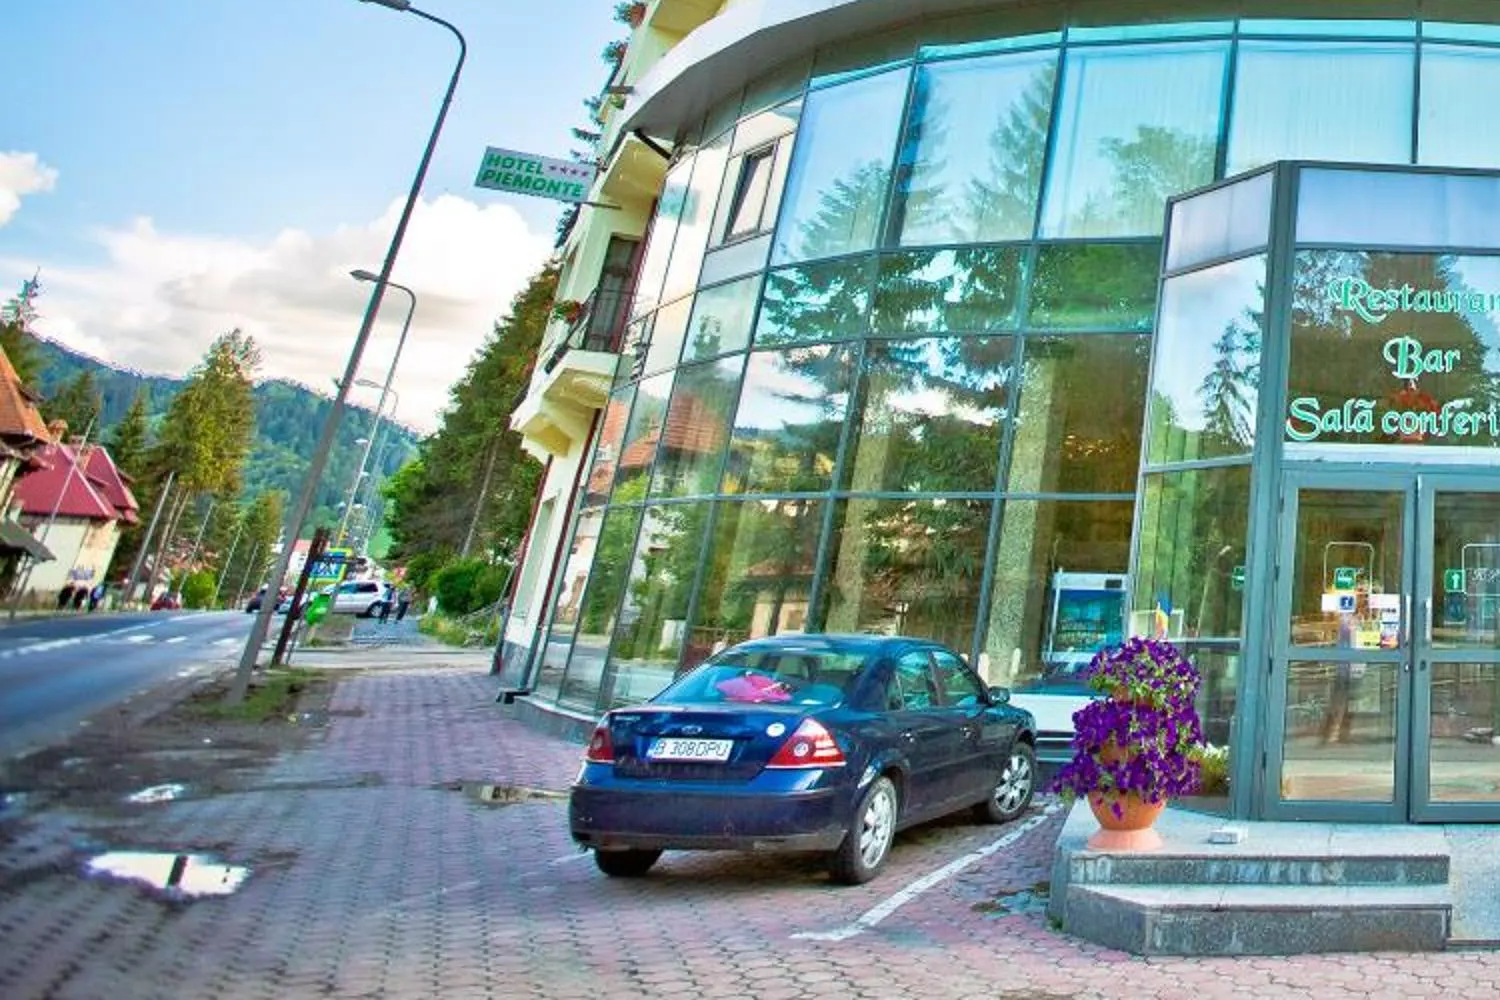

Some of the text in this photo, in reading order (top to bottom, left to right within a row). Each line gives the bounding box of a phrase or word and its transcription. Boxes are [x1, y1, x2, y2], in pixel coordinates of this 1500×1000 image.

[486, 153, 544, 175] HOTEL
[481, 169, 584, 197] PIEMONTE
[1382, 335, 1461, 379] Bar
